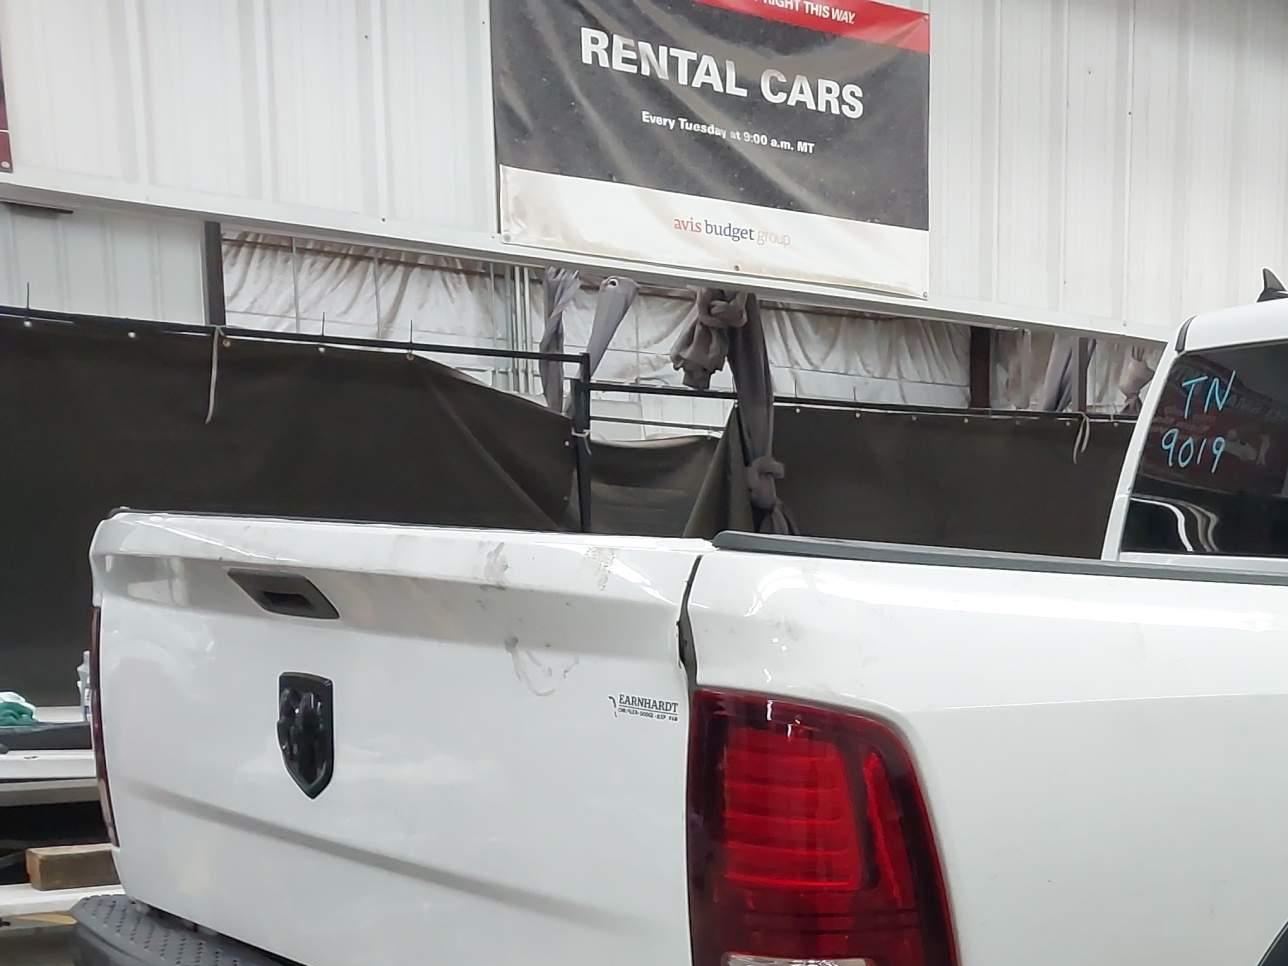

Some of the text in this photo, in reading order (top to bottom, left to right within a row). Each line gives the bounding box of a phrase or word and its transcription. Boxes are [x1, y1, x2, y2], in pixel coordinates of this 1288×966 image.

[803, 1, 830, 18] THIS
[581, 27, 864, 119] RENTAL CARS
[641, 111, 815, 154] Every Tuesday at 9:00 a.m. MT
[673, 217, 791, 248] avis budget group
[1181, 369, 1236, 420] TN
[1161, 427, 1226, 475] 9019
[618, 693, 680, 713] EARNHARDT
